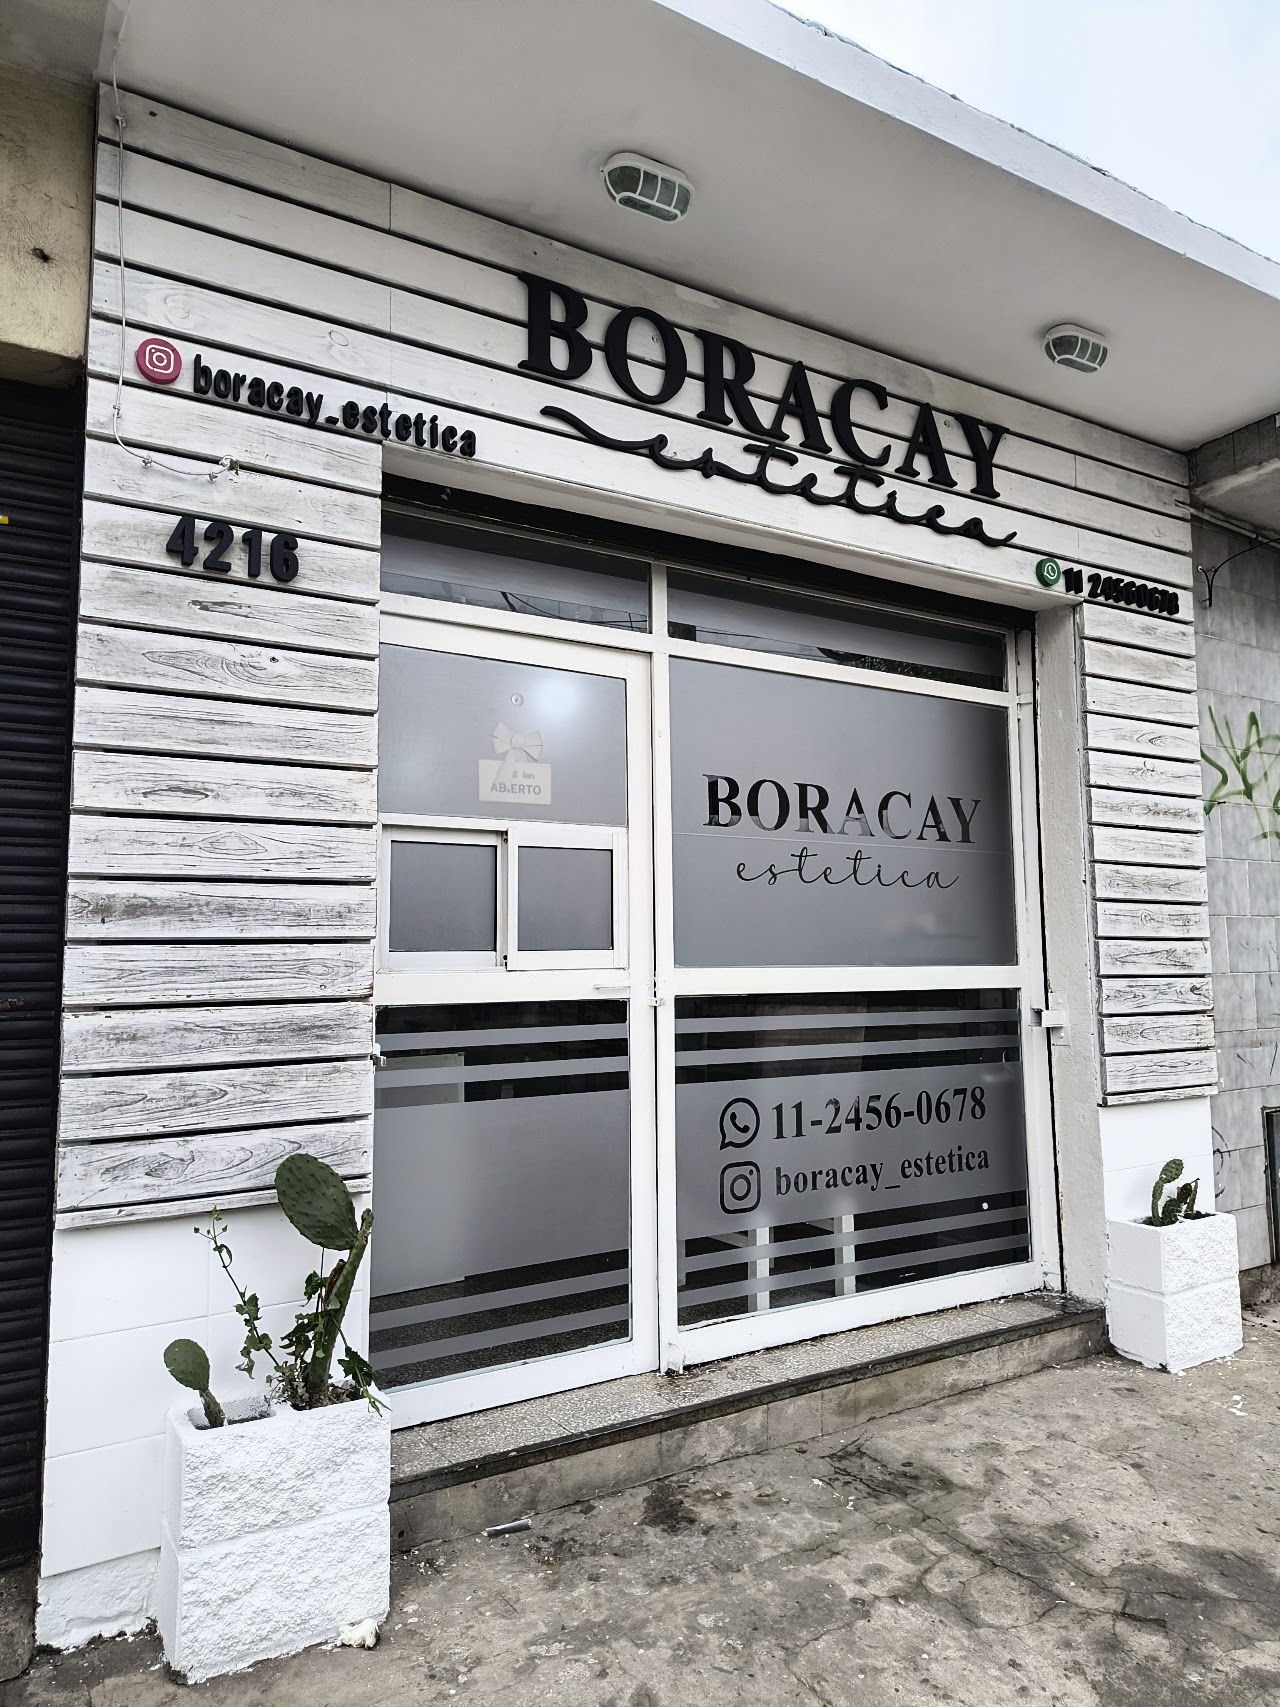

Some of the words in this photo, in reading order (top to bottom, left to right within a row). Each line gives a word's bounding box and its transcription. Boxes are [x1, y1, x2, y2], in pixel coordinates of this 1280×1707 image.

[193, 354, 477, 458] boracay_estetica
[517, 271, 1010, 500] BORACAY
[541, 405, 1018, 547] estetica
[166, 515, 299, 582] 4216
[1062, 567, 1083, 594] 11
[702, 773, 981, 844] BORACAY
[736, 846, 960, 889] estetica
[771, 1086, 986, 1140] 11-2456-0678
[775, 1145, 990, 1197] boracay_estetica
